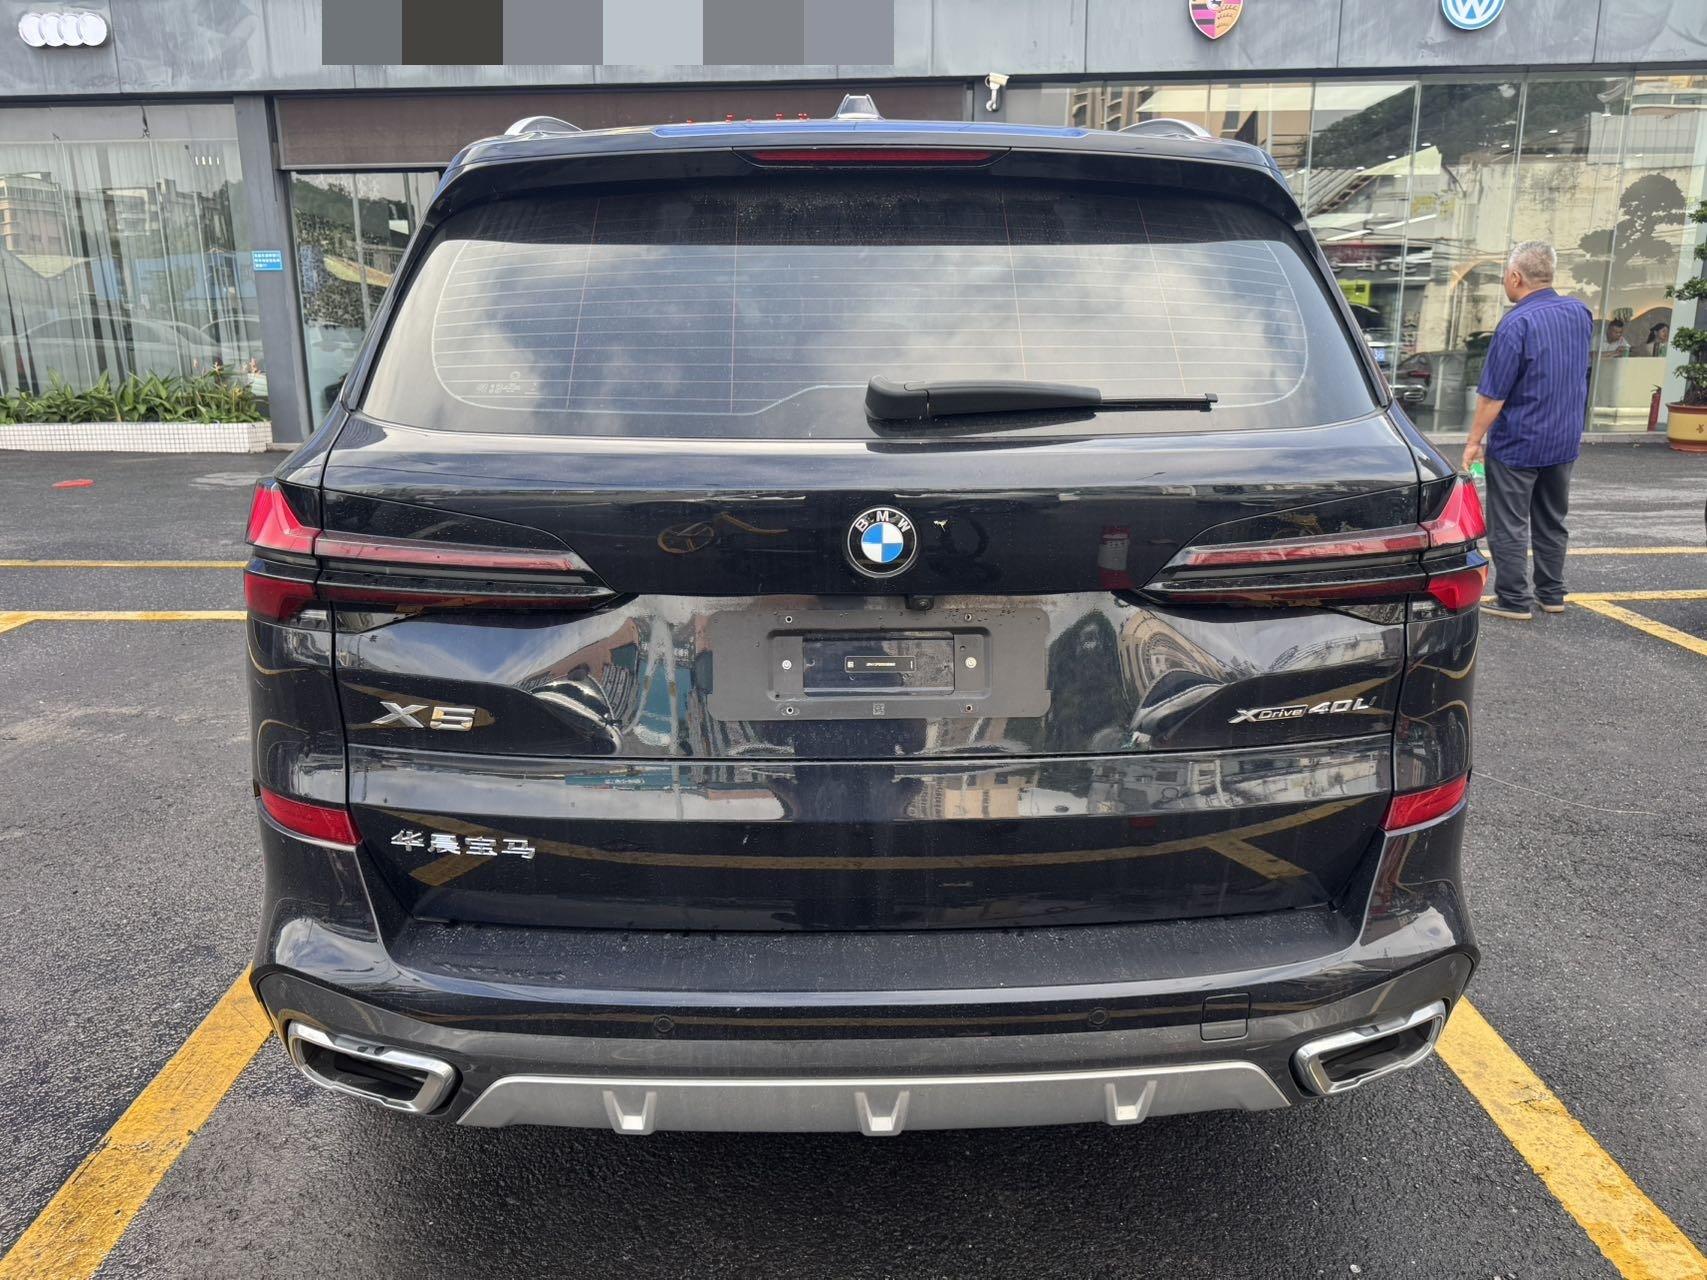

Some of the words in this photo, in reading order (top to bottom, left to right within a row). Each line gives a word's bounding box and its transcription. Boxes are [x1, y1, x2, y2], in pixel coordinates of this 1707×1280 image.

[855, 510, 911, 532] BMW
[371, 701, 476, 732] X5
[390, 829, 536, 859] 华晨宝马
